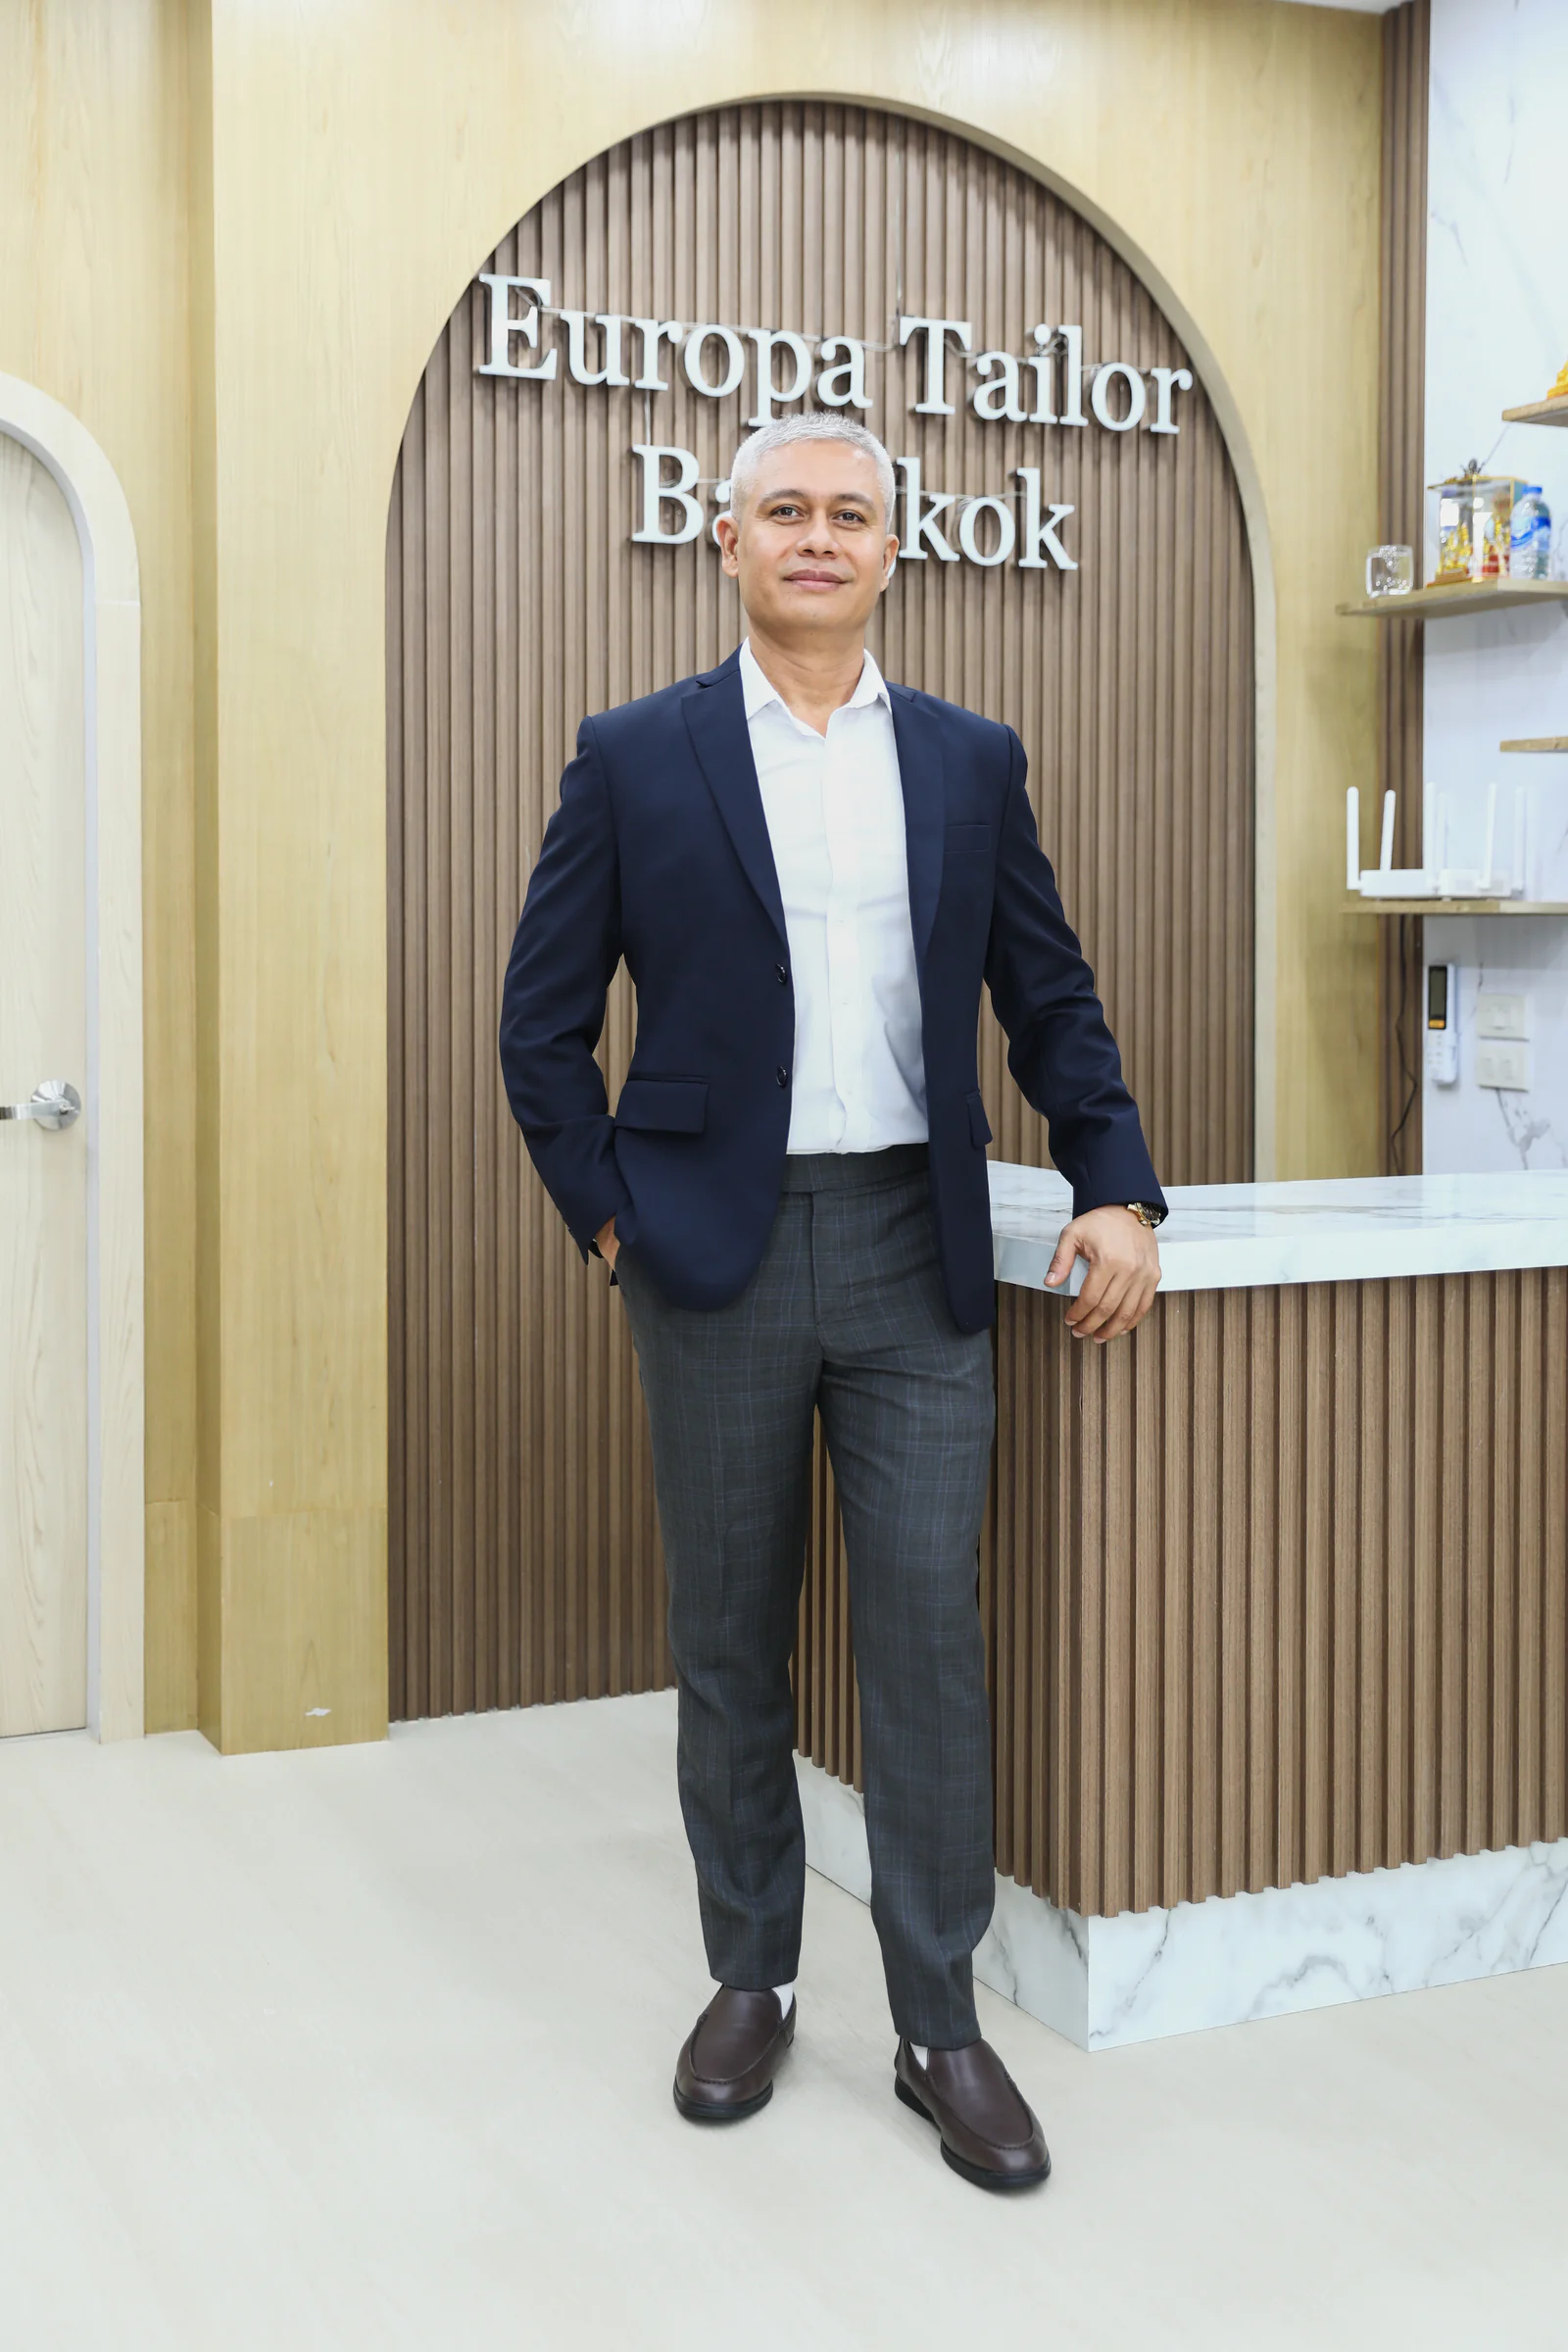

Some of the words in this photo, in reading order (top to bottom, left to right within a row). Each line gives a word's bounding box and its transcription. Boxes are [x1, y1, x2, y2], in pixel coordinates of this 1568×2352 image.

[478, 273, 873, 427] Europa
[899, 316, 1194, 434] Tailor
[632, 444, 1078, 579] Bkok
